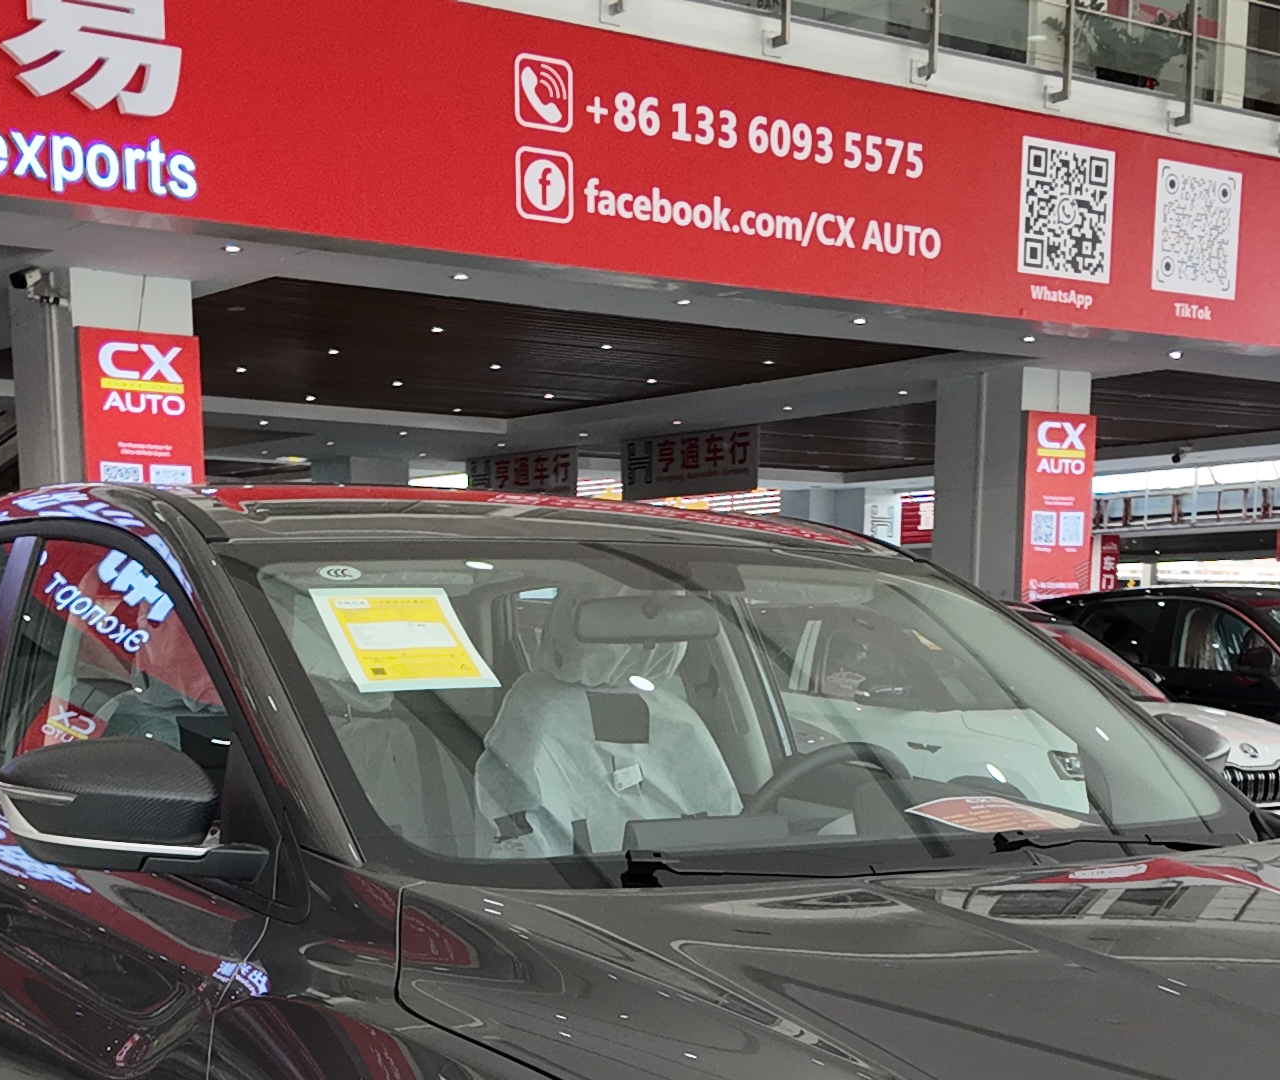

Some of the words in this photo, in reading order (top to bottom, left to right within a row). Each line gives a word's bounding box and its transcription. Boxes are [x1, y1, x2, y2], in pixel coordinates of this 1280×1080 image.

[586, 92, 660, 136] +86
[672, 102, 738, 149] 133
[748, 116, 833, 164] 6093
[844, 131, 924, 179] 5575
[584, 178, 856, 249] facebook.com/CX
[862, 219, 942, 259] AUTO
[1030, 285, 1093, 309] WhatsApp
[1174, 302, 1212, 321] TikTok
[98, 341, 184, 383] CX
[103, 391, 186, 416] AUTO
[1037, 421, 1087, 450] CX
[657, 431, 751, 473] 亨通车行
[1036, 458, 1086, 475] AUTO
[494, 453, 571, 489] 亨通车行
